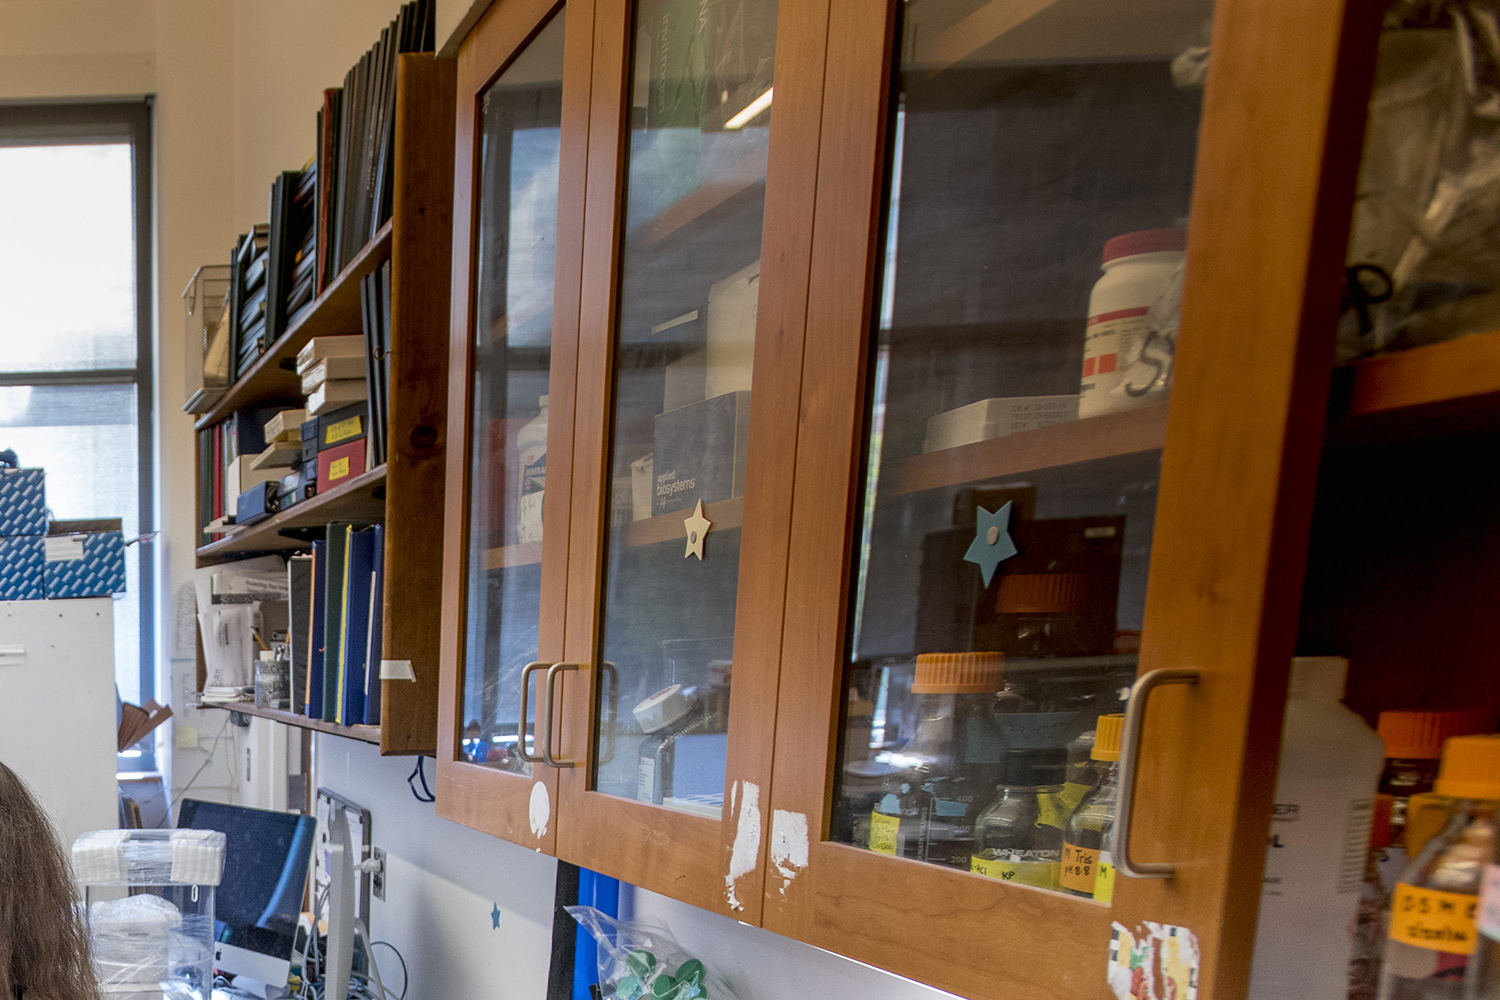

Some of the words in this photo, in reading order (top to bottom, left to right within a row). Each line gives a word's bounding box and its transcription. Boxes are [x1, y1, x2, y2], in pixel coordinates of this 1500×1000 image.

[656, 469, 676, 485] applied
[656, 478, 697, 496] biosystems
[957, 795, 974, 803] 400
[953, 826, 970, 834] 300
[992, 847, 1060, 858] WHEATON
[1075, 848, 1093, 865] Tris
[950, 856, 967, 864] 200
[1001, 870, 1016, 880] KP
